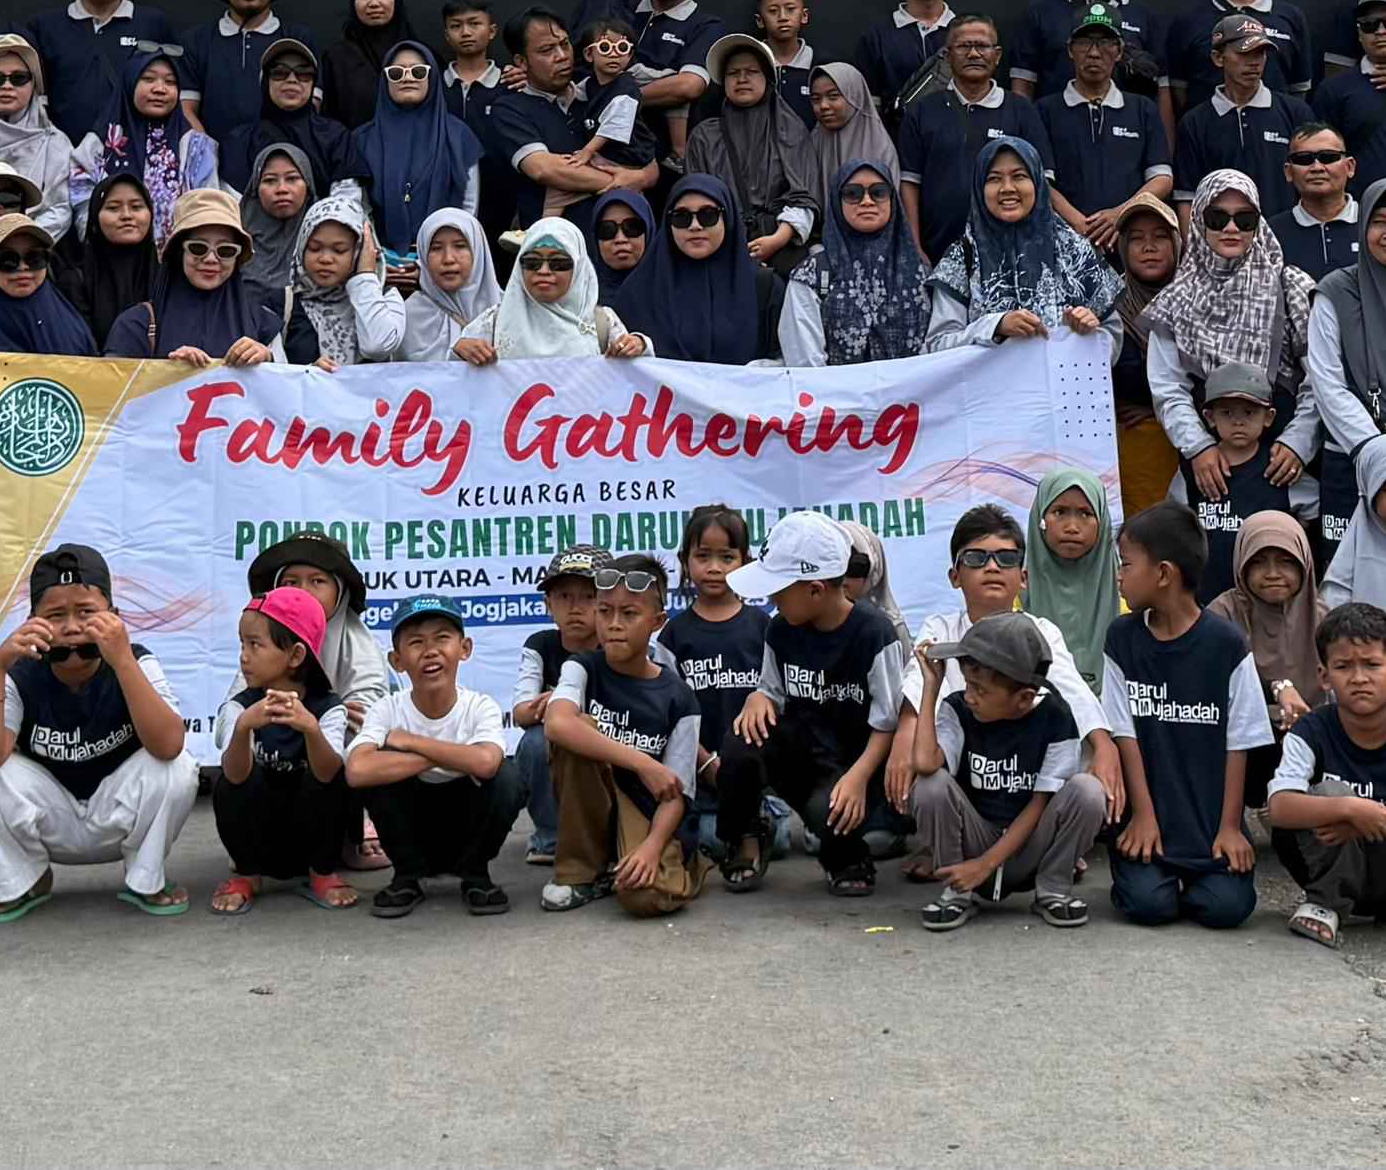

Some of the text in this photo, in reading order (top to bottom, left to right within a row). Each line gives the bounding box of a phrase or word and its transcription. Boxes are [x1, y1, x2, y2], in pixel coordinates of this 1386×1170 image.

[176, 381, 472, 497] Family
[504, 383, 921, 475] Gathering
[457, 479, 676, 507] KELUARGA BESAR
[1198, 501, 1231, 517] Darul
[385, 515, 576, 560] PESANTREN
[592, 509, 691, 552] DARU
[1206, 514, 1243, 532] Mujah
[405, 568, 491, 589] UTARA
[512, 566, 549, 586] MA
[460, 597, 550, 623] Jogjaka
[683, 654, 723, 675] Darul
[1125, 681, 1167, 700] Darul
[590, 699, 630, 726] Darul
[1138, 697, 1220, 721] Mujahadah
[35, 725, 81, 745] Darul
[47, 723, 134, 762] Mujahadah
[971, 752, 1018, 775] Darul
